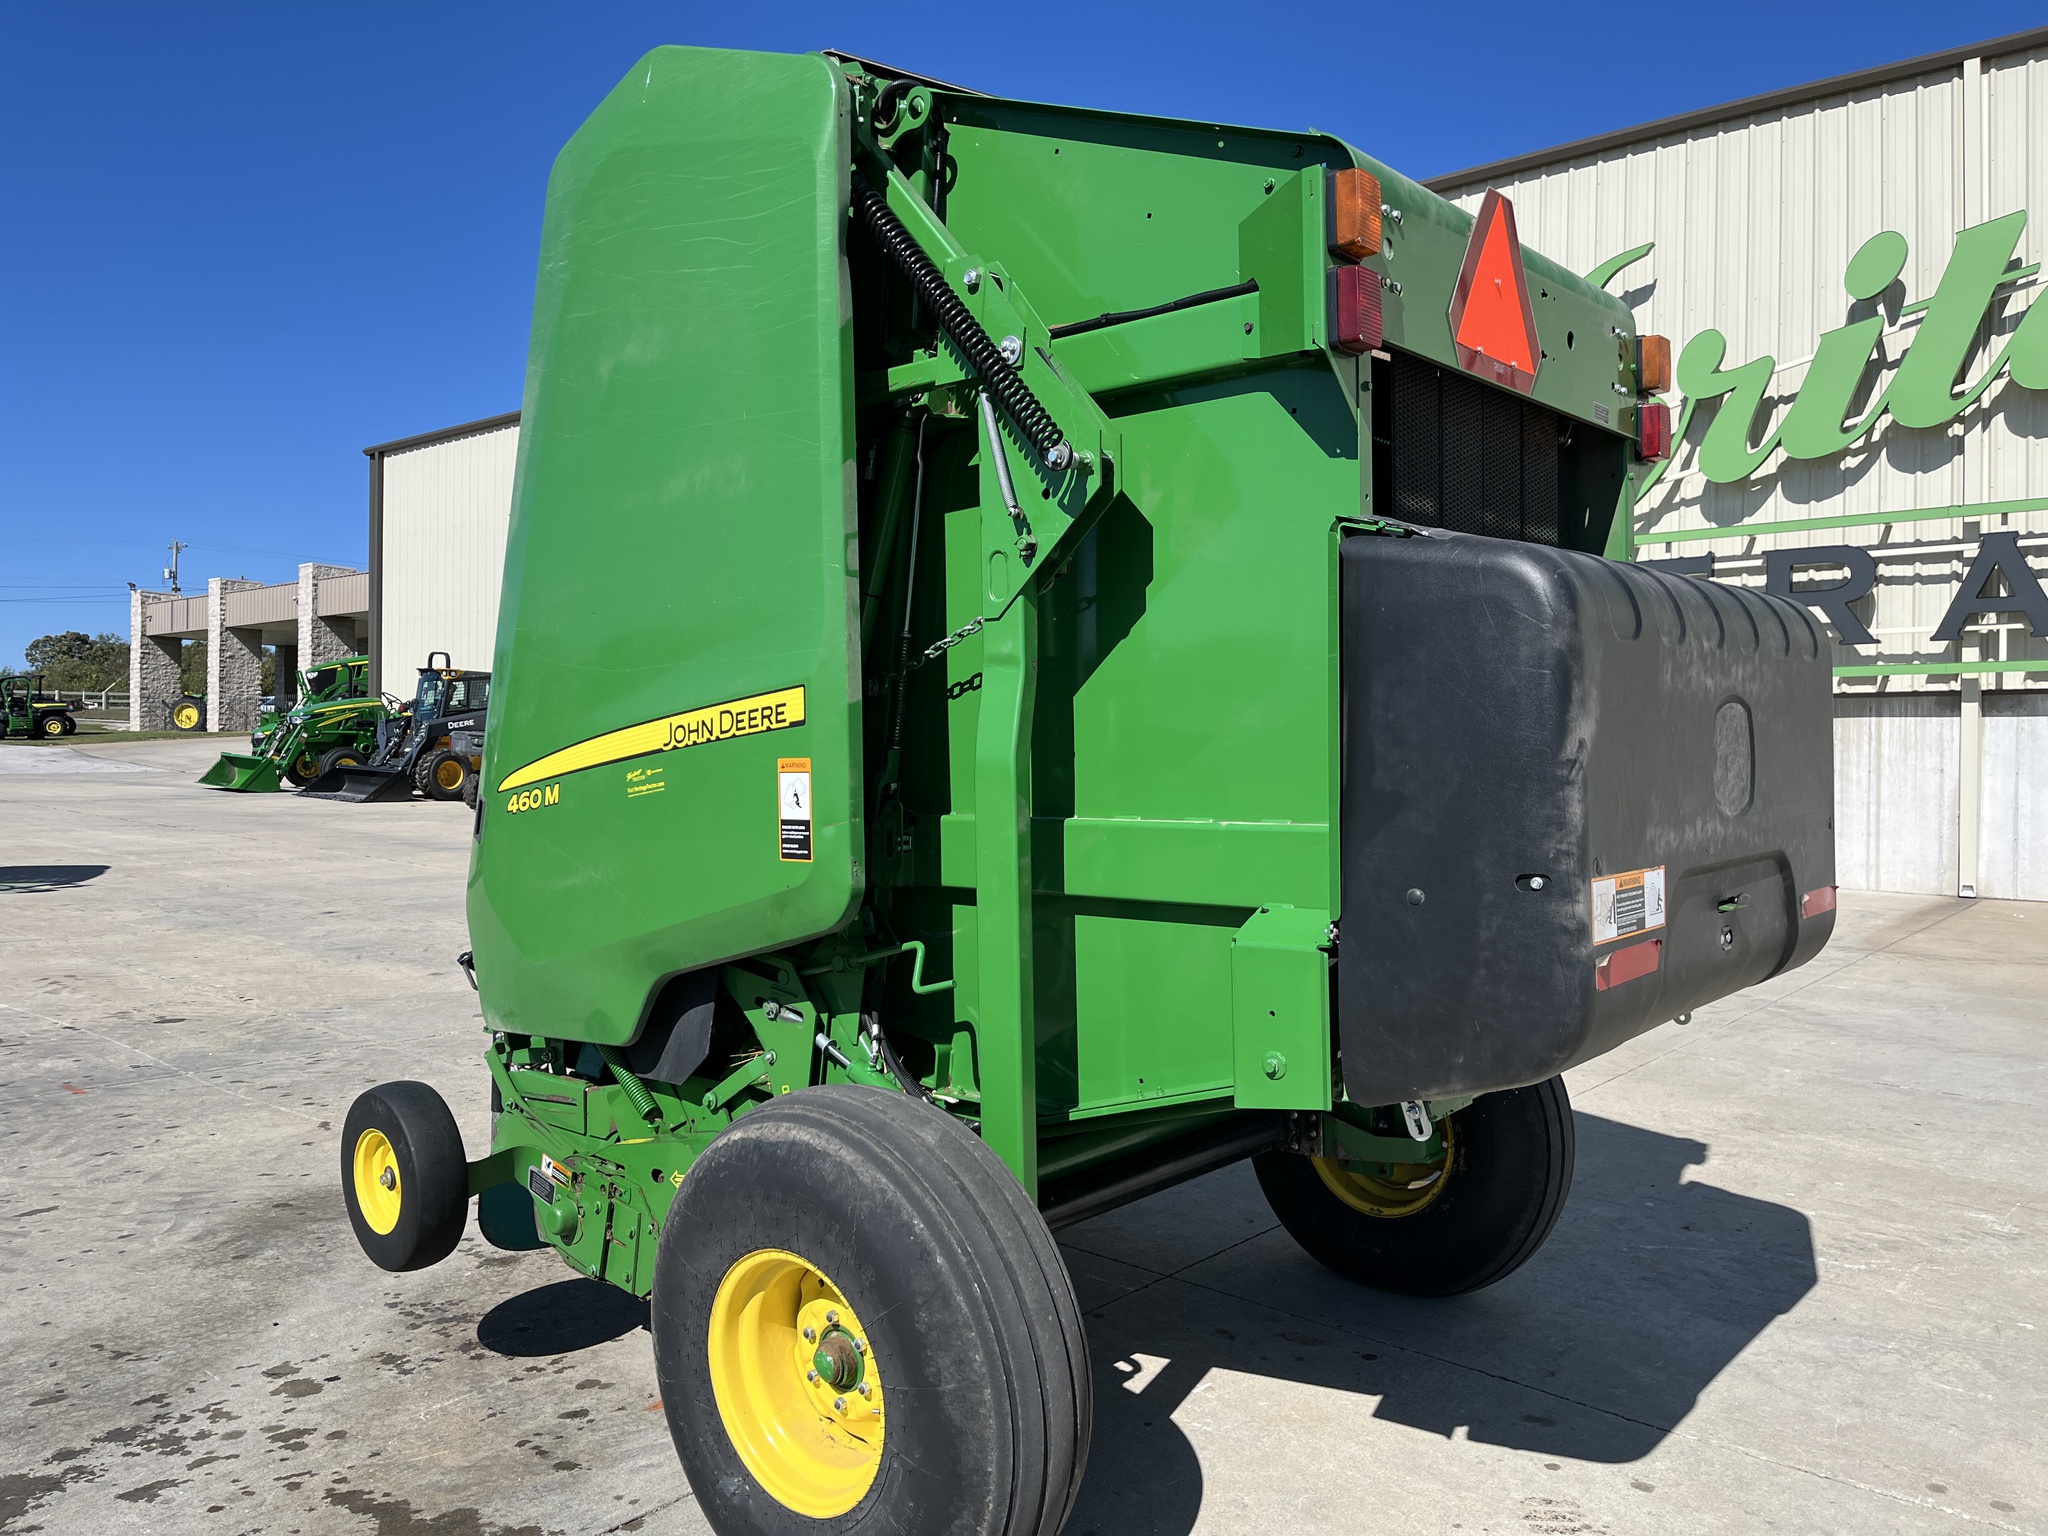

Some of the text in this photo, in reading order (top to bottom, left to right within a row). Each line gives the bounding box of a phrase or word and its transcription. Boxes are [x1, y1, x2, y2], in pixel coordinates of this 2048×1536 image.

[1584, 209, 2048, 502] rit
[1638, 531, 2048, 645] RA
[447, 719, 475, 730] DEERE
[662, 703, 787, 747] JOHN DEERE
[1623, 876, 1641, 886] WARNING
